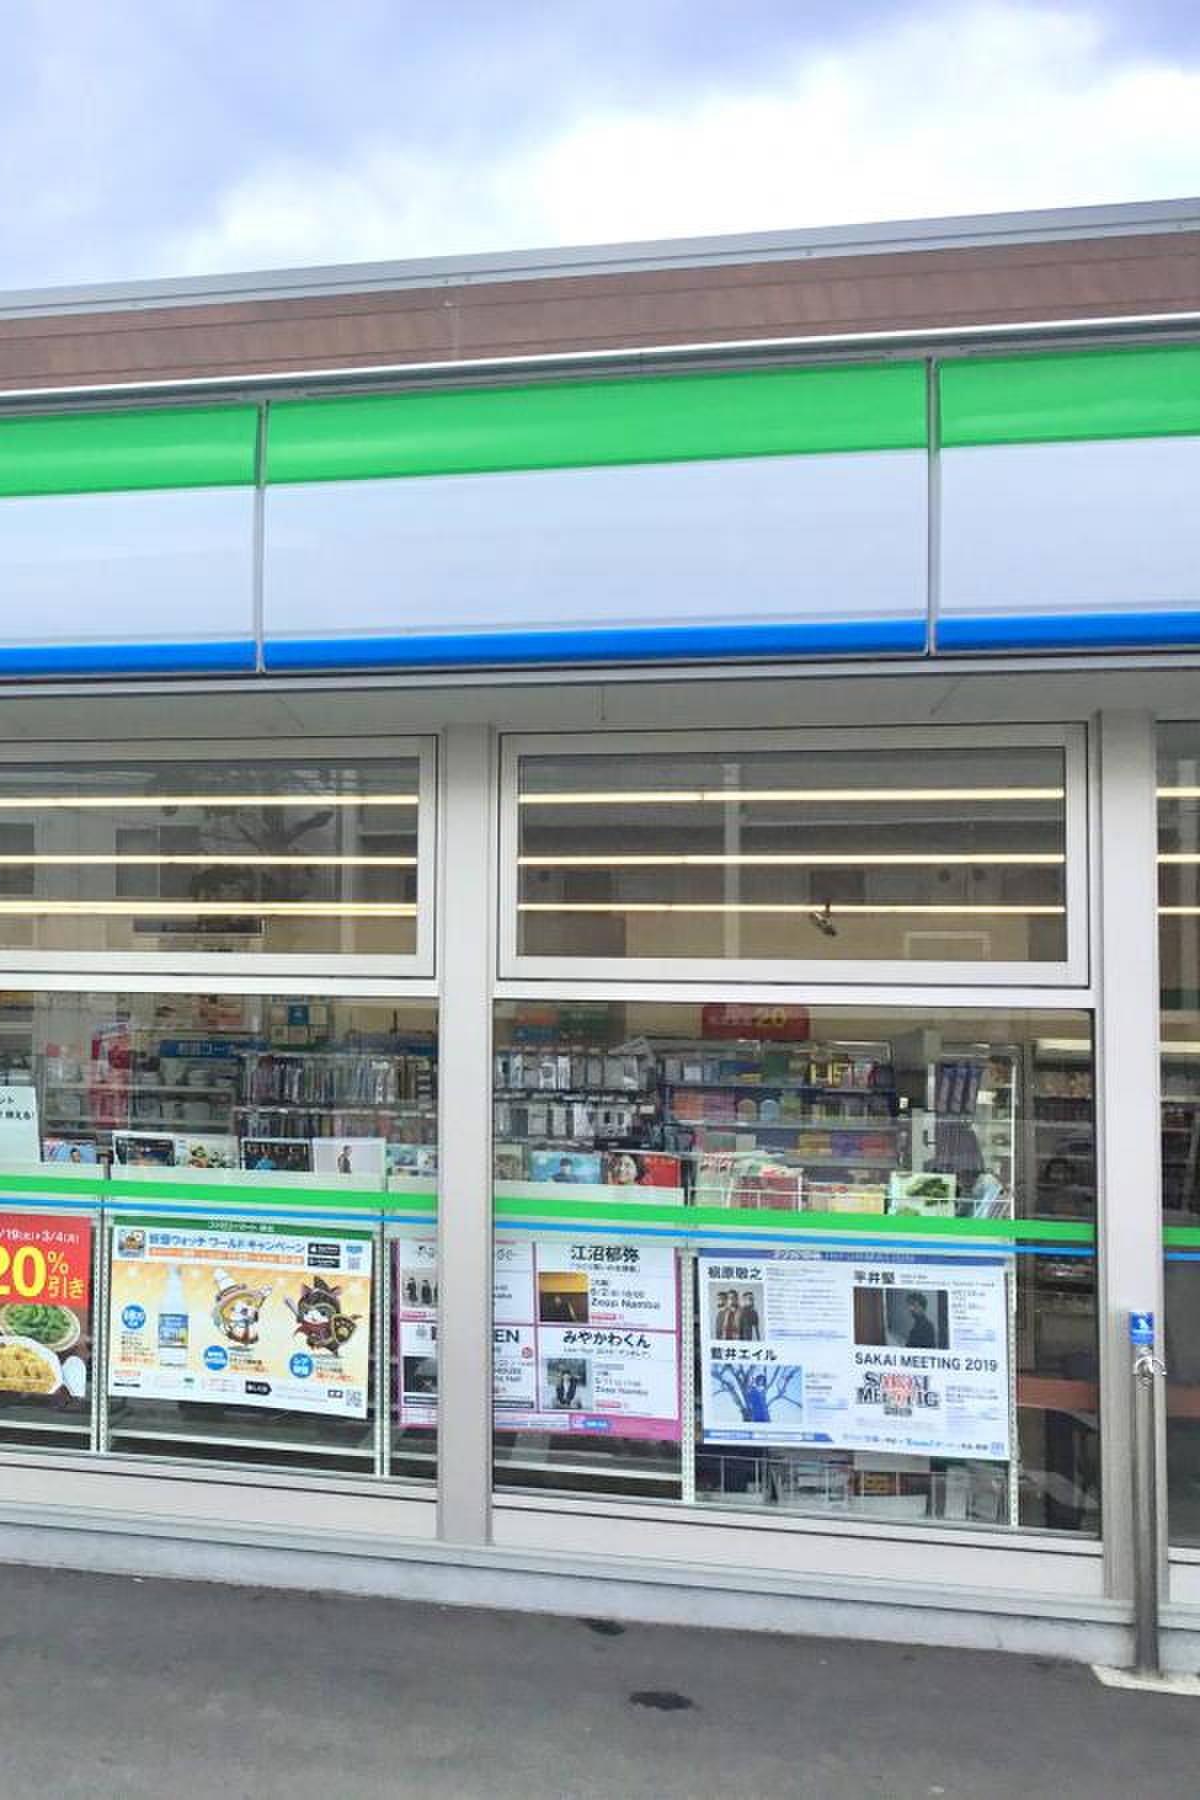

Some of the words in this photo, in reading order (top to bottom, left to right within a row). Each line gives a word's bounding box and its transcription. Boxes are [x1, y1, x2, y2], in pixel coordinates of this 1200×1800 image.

[562, 1329, 651, 1348] みやかわくん
[854, 1351, 897, 1366] SAKAI
[900, 1354, 961, 1371] MEETING
[964, 1357, 998, 1372] 2019
